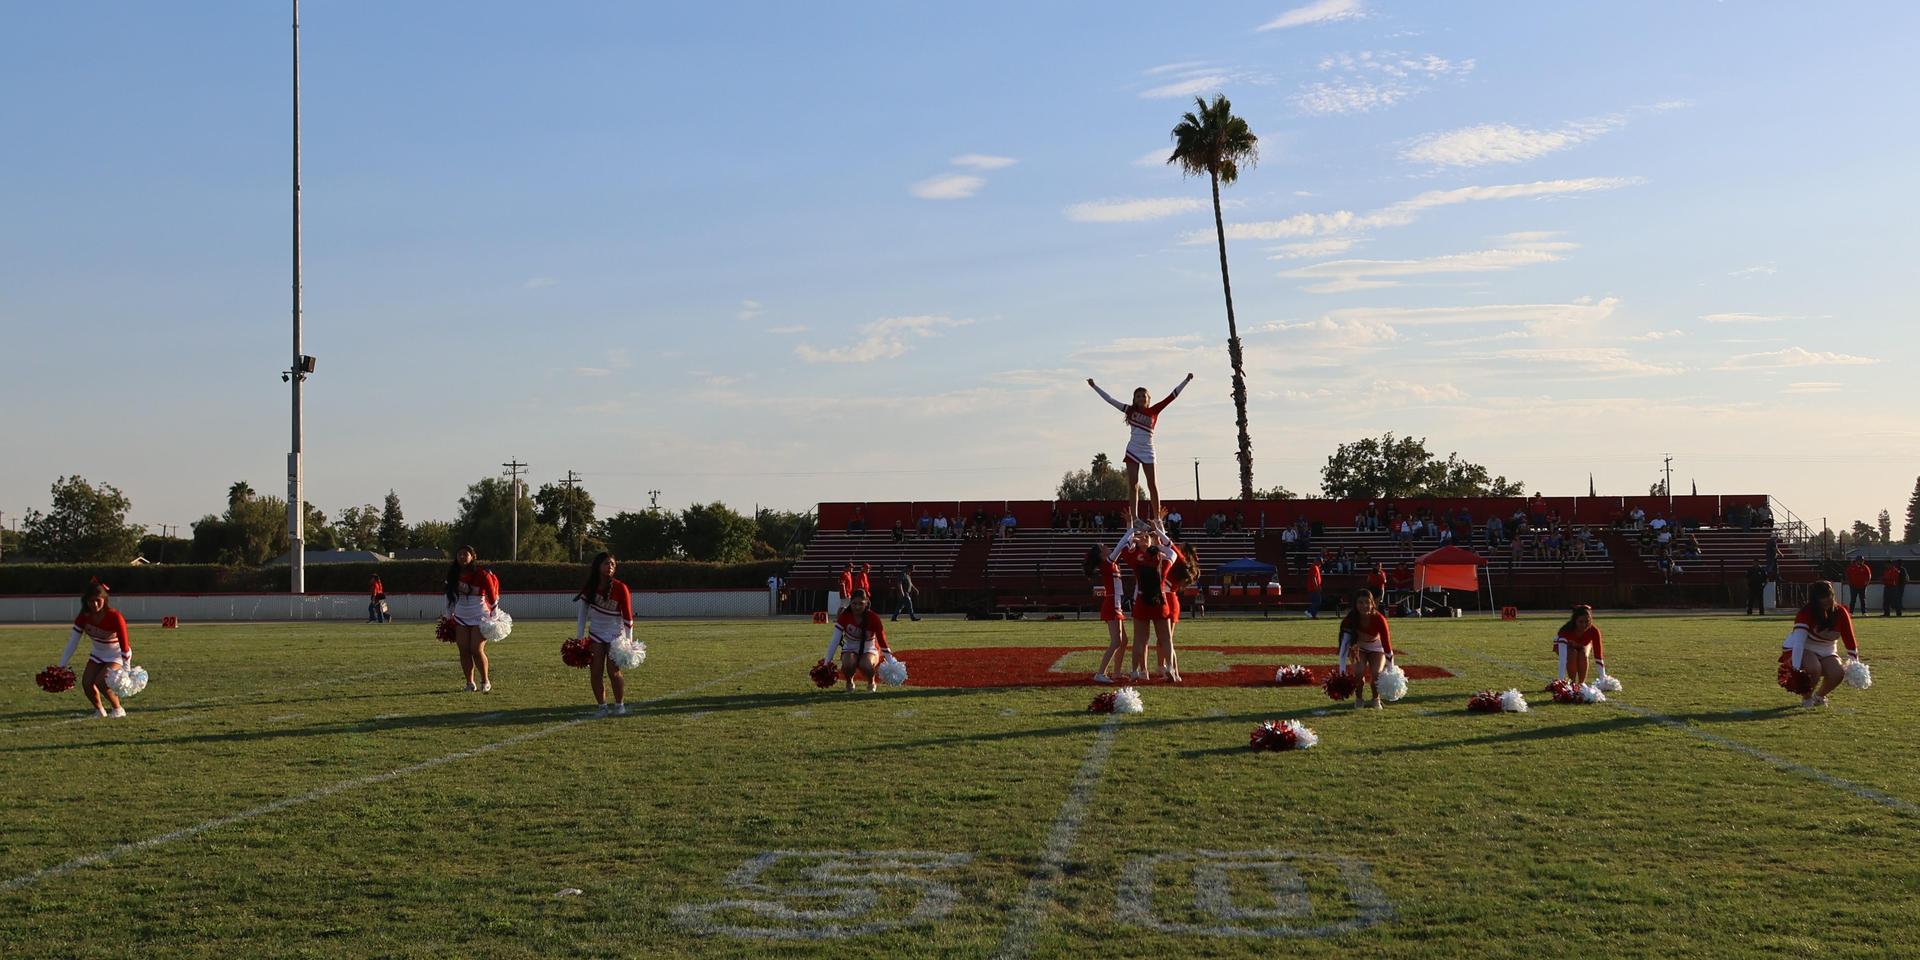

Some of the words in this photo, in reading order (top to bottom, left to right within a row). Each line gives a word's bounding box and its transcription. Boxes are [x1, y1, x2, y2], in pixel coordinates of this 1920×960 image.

[814, 612, 826, 622] 40
[1504, 608, 1516, 618] 40
[163, 616, 175, 626] 20
